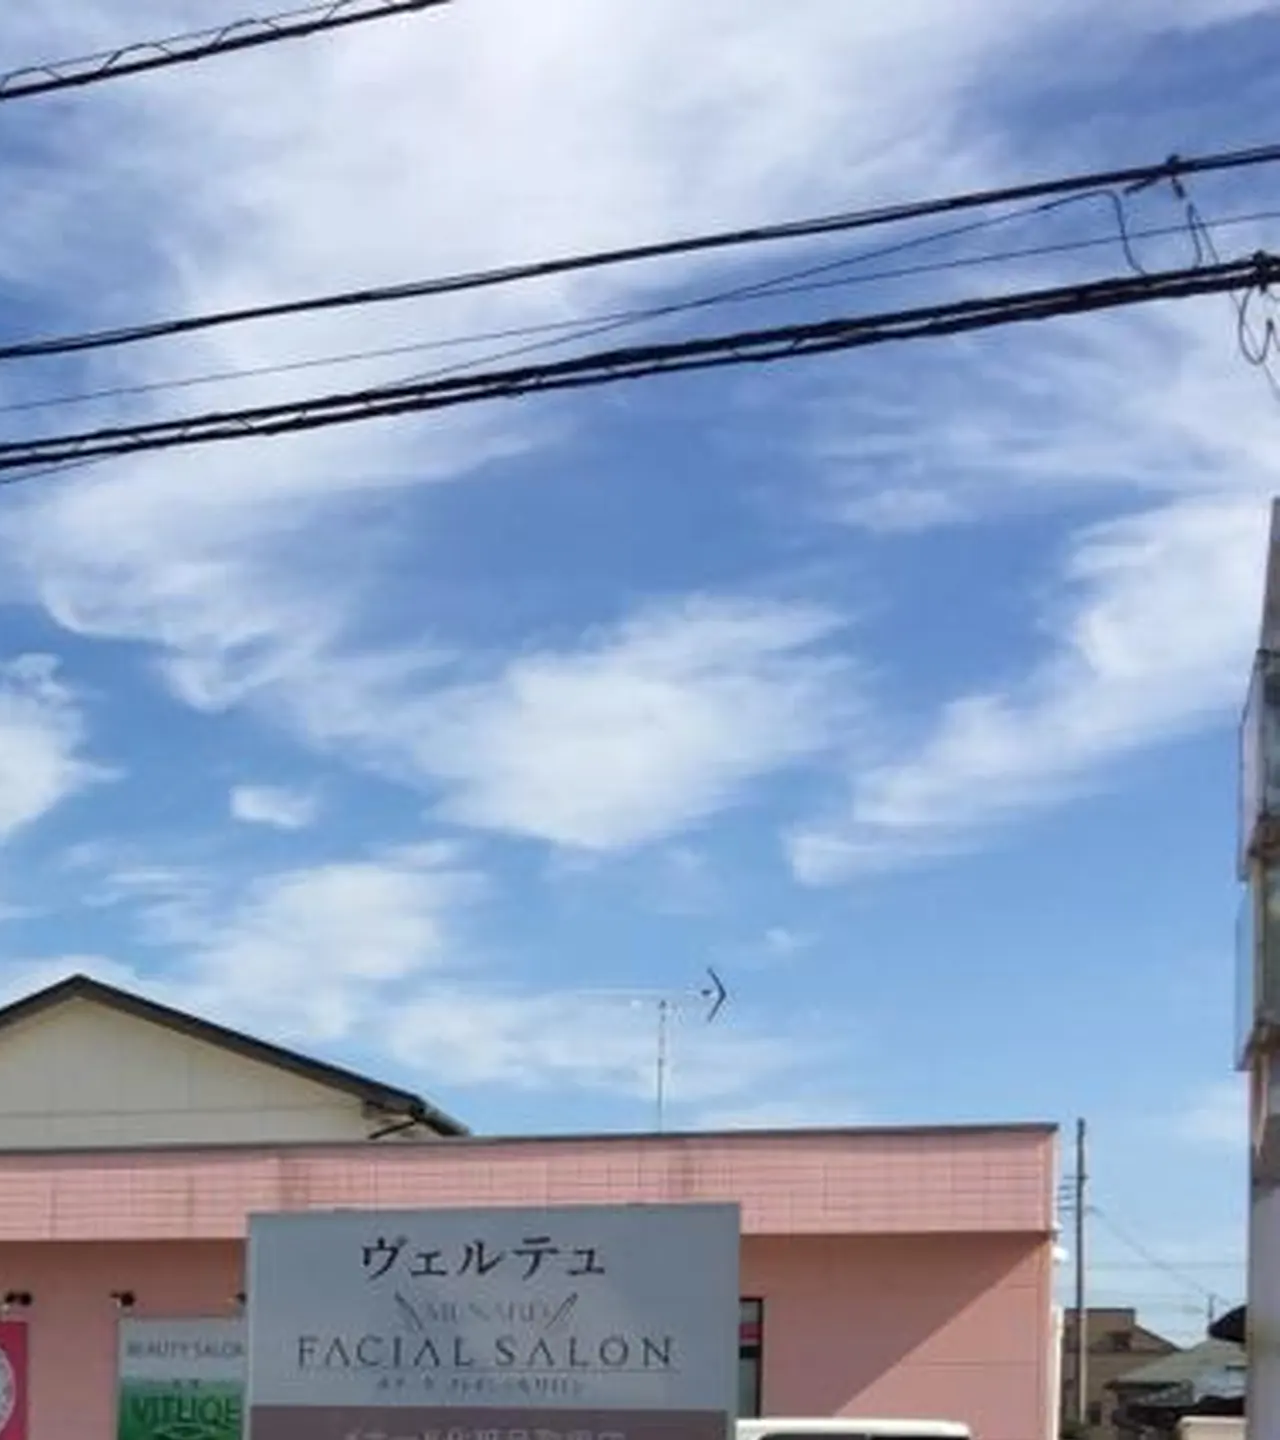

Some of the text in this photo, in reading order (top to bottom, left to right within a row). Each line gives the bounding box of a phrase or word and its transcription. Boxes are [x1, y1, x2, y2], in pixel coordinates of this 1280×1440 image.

[361, 1235, 606, 1280] ヴェルテュ
[297, 1334, 673, 1369] FACIAL SALON
